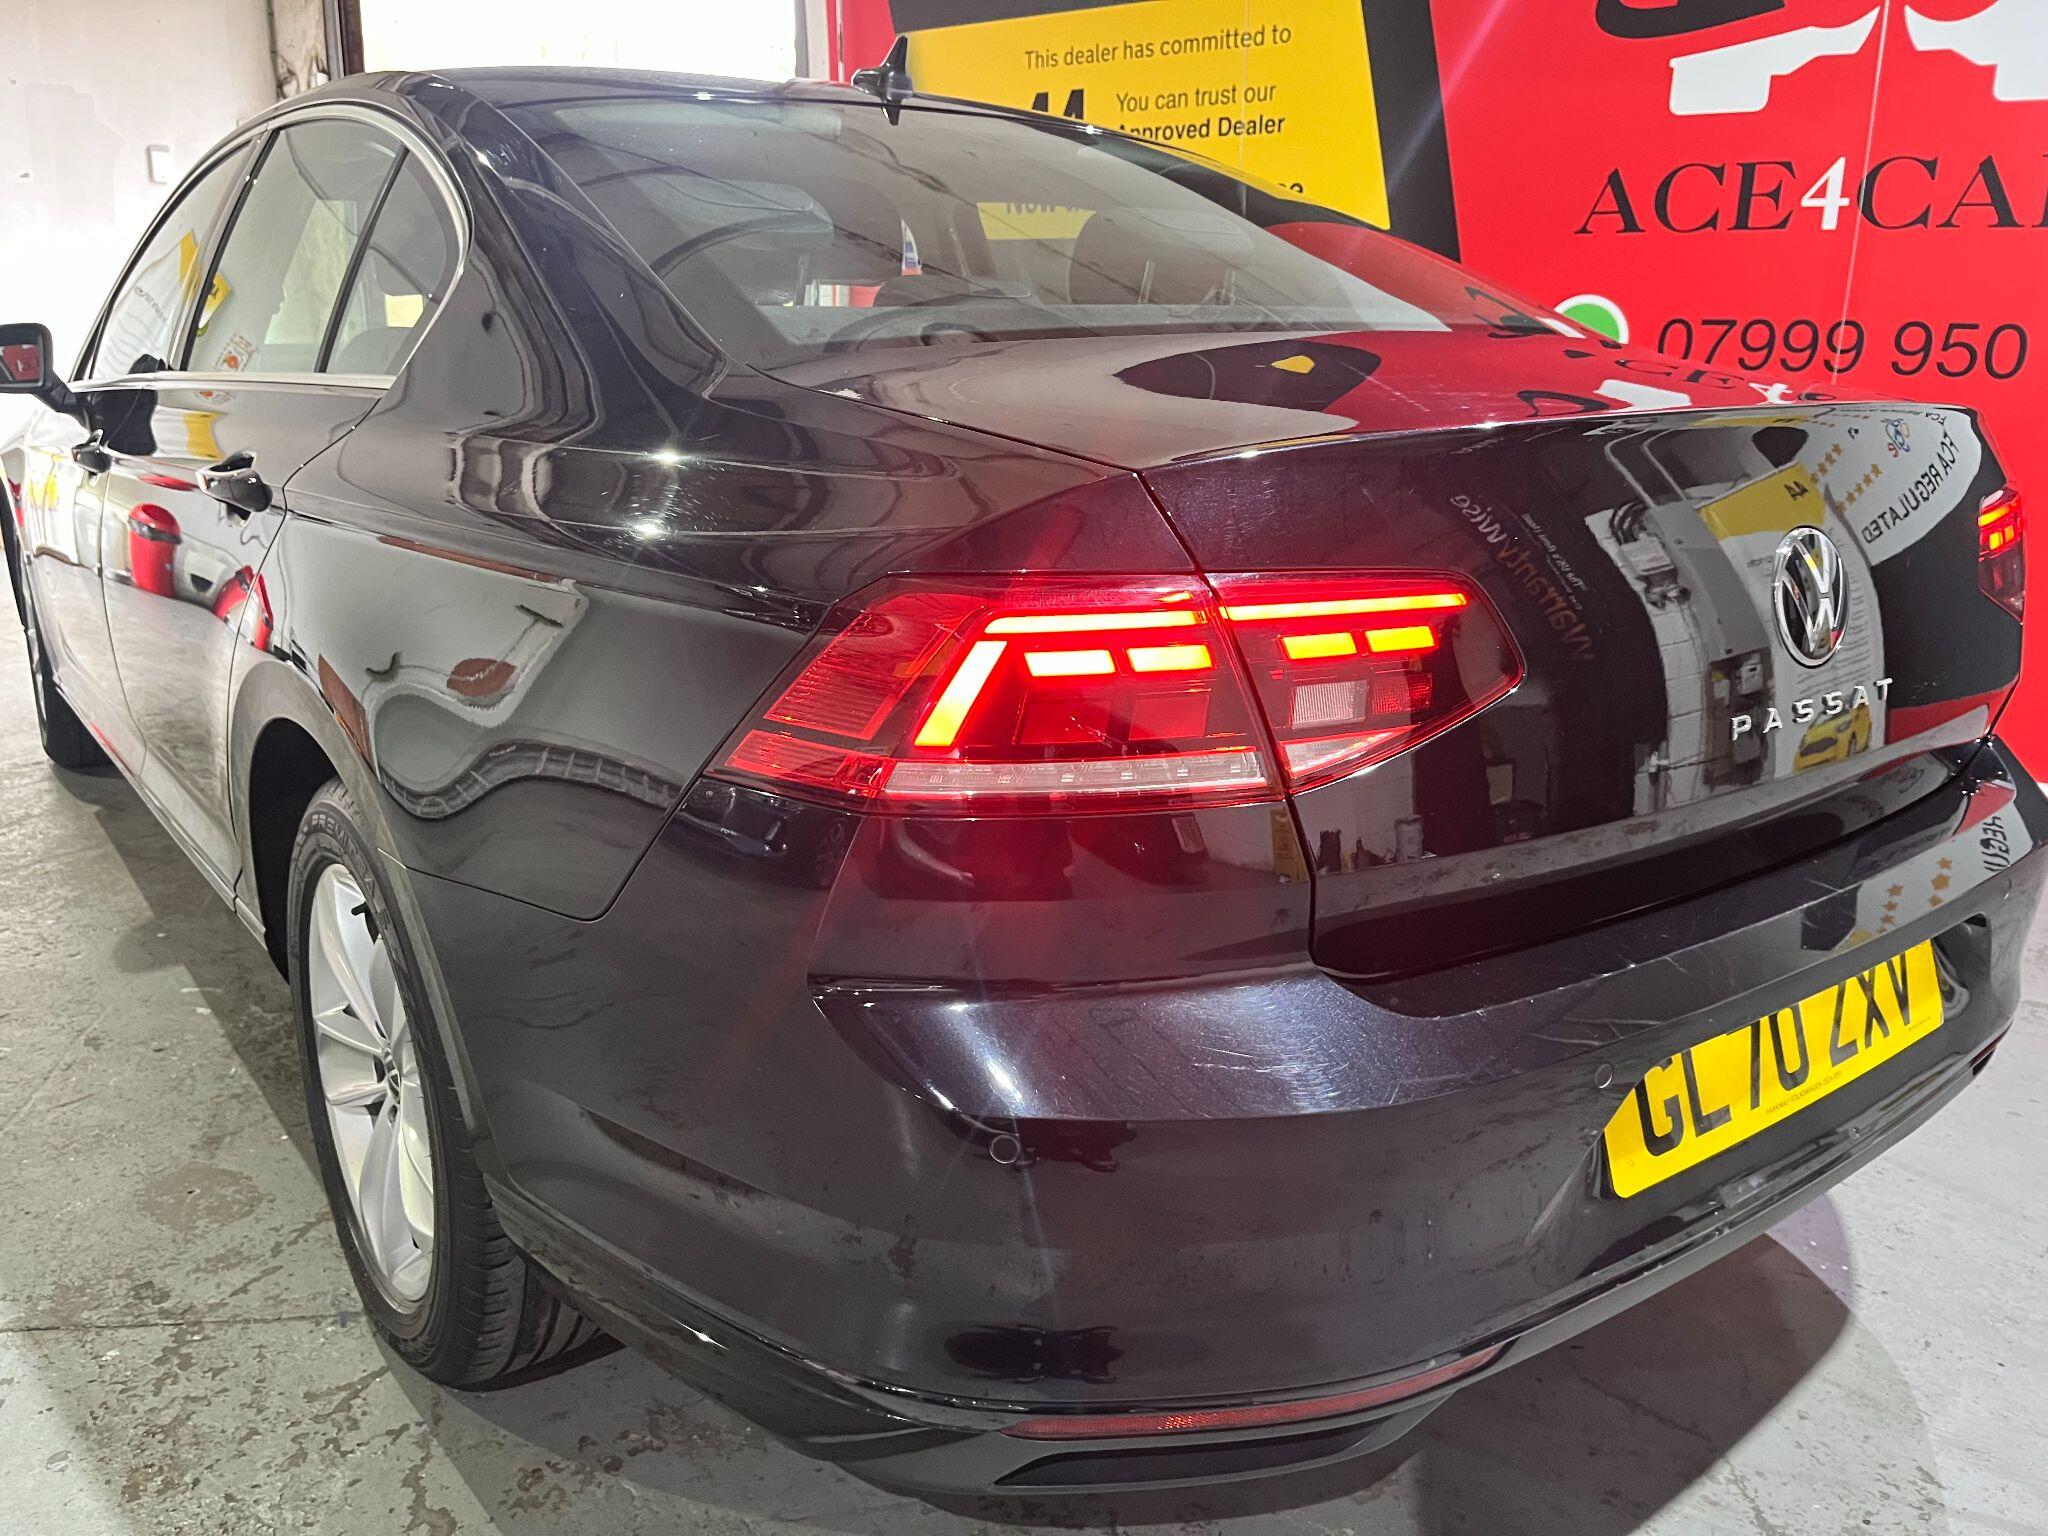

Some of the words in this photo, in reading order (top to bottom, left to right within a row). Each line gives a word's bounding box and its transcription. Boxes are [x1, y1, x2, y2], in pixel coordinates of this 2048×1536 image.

[1025, 50, 1059, 70] This
[1063, 46, 1118, 66] dealer
[1123, 40, 1154, 60] has
[1160, 25, 1265, 56] committed
[1272, 24, 1292, 44] to
[1116, 92, 1149, 113] You
[1155, 91, 1189, 110] can
[1195, 85, 1237, 107] trust
[1244, 83, 1277, 103] our
[1218, 116, 1286, 137] Dealer
[1574, 155, 2048, 236] ACE4CA
[1657, 318, 1865, 374] 07999
[1891, 320, 2029, 380] 950
[1731, 678, 1893, 741] PASSAT
[1633, 1001, 1811, 1157] GL70
[1829, 951, 1911, 1068] ZXV
